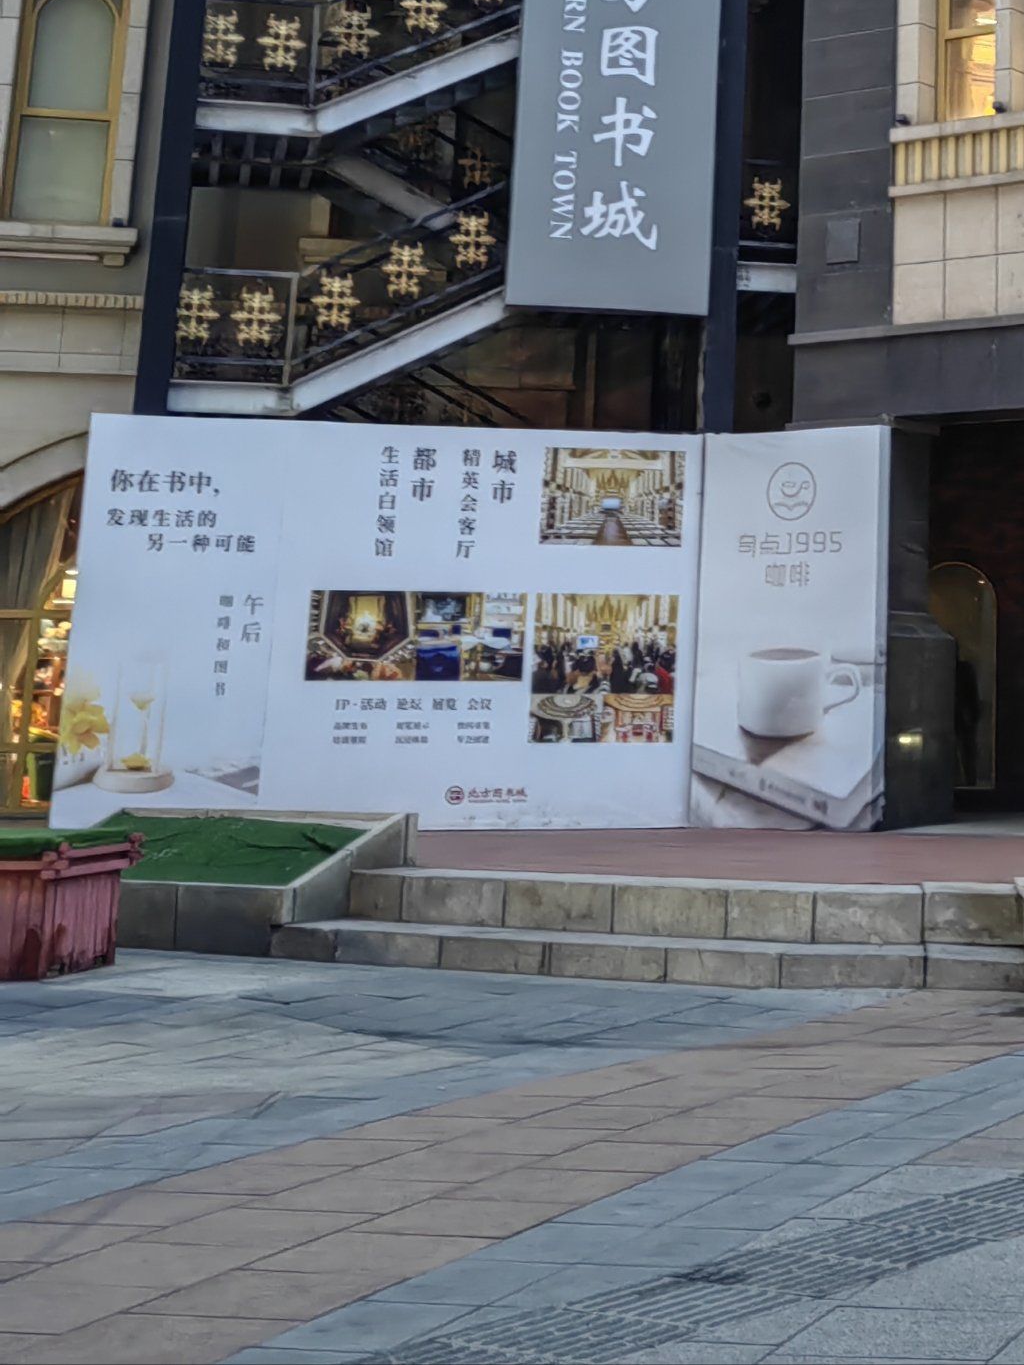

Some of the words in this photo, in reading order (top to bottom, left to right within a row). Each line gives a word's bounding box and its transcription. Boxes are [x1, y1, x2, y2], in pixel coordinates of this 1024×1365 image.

[556, 49, 585, 133] BOOK
[549, 150, 578, 240] TOWN
[374, 445, 400, 557] 生活白领馆
[410, 447, 437, 502] 都市
[491, 449, 518, 504] 城市
[106, 507, 218, 529] 发现生活的
[456, 448, 481, 559] 精英会客厅
[146, 533, 256, 554] 另一种可能
[765, 560, 811, 587] 咖啡
[240, 593, 264, 644] 午后
